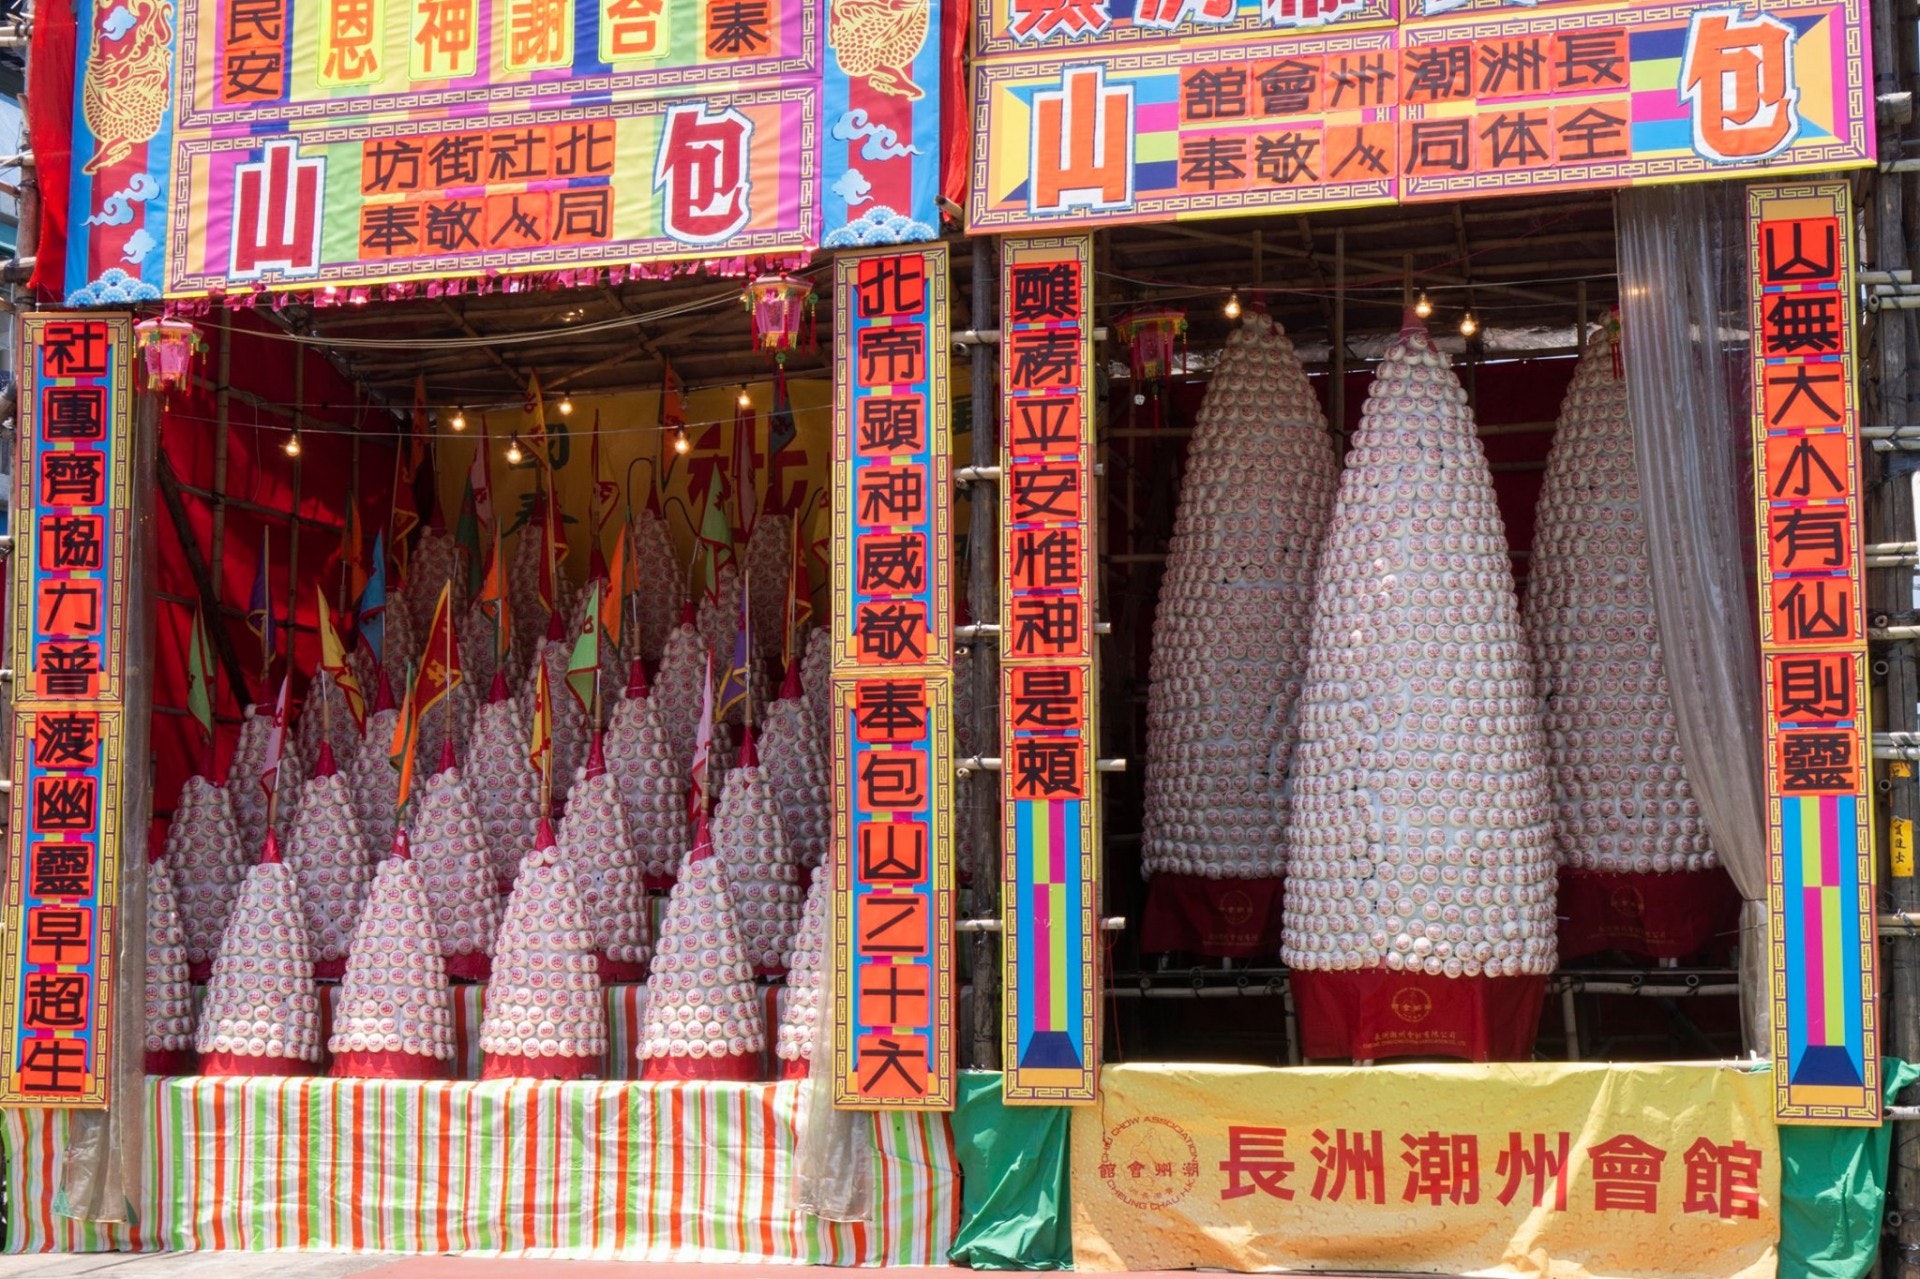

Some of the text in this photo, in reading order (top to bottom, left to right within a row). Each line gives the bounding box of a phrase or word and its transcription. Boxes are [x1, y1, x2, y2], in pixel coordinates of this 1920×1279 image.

[708, 2, 768, 51] 泰
[1034, 14, 1797, 210] 包 山
[236, 107, 748, 276] 包 山
[1219, 1126, 1762, 1219] 長洲潮州會館
